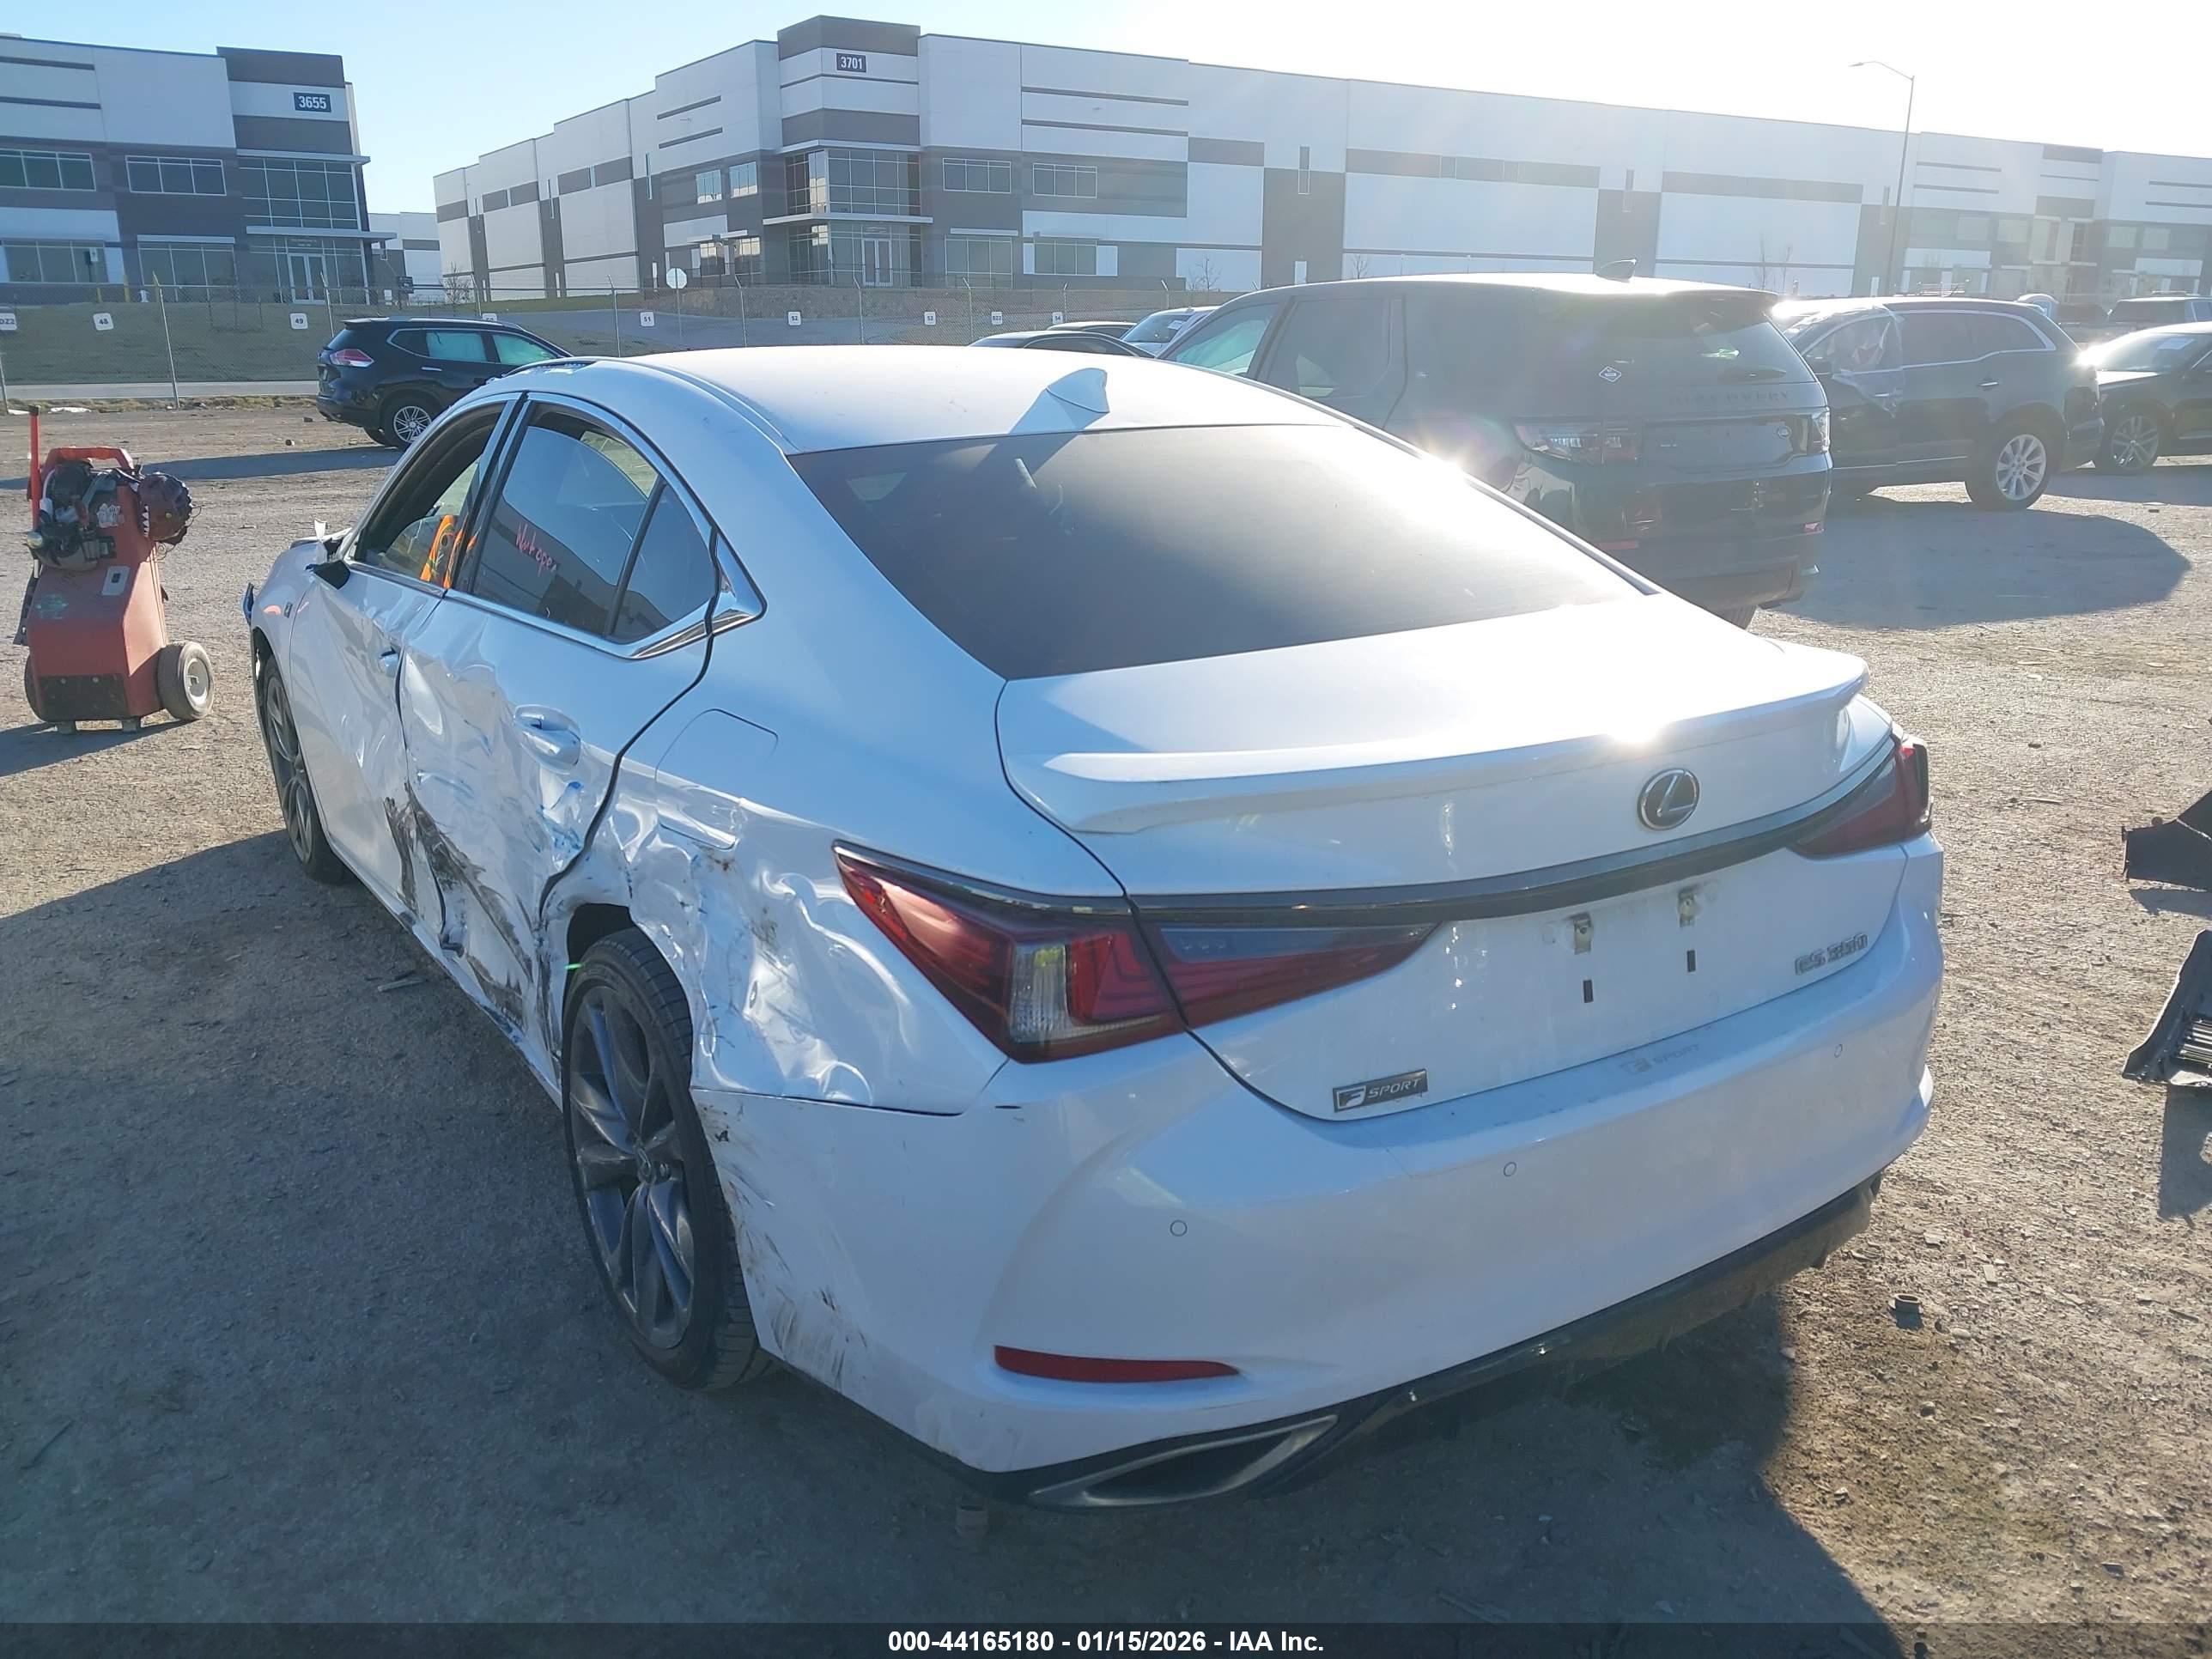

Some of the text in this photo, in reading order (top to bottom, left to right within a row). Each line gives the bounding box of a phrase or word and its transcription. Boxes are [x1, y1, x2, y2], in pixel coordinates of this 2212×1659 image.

[841, 56, 862, 69] 3701
[298, 95, 326, 109] 3655
[1668, 391, 1790, 406] OVERY
[1368, 1078, 1421, 1098] SPORT
